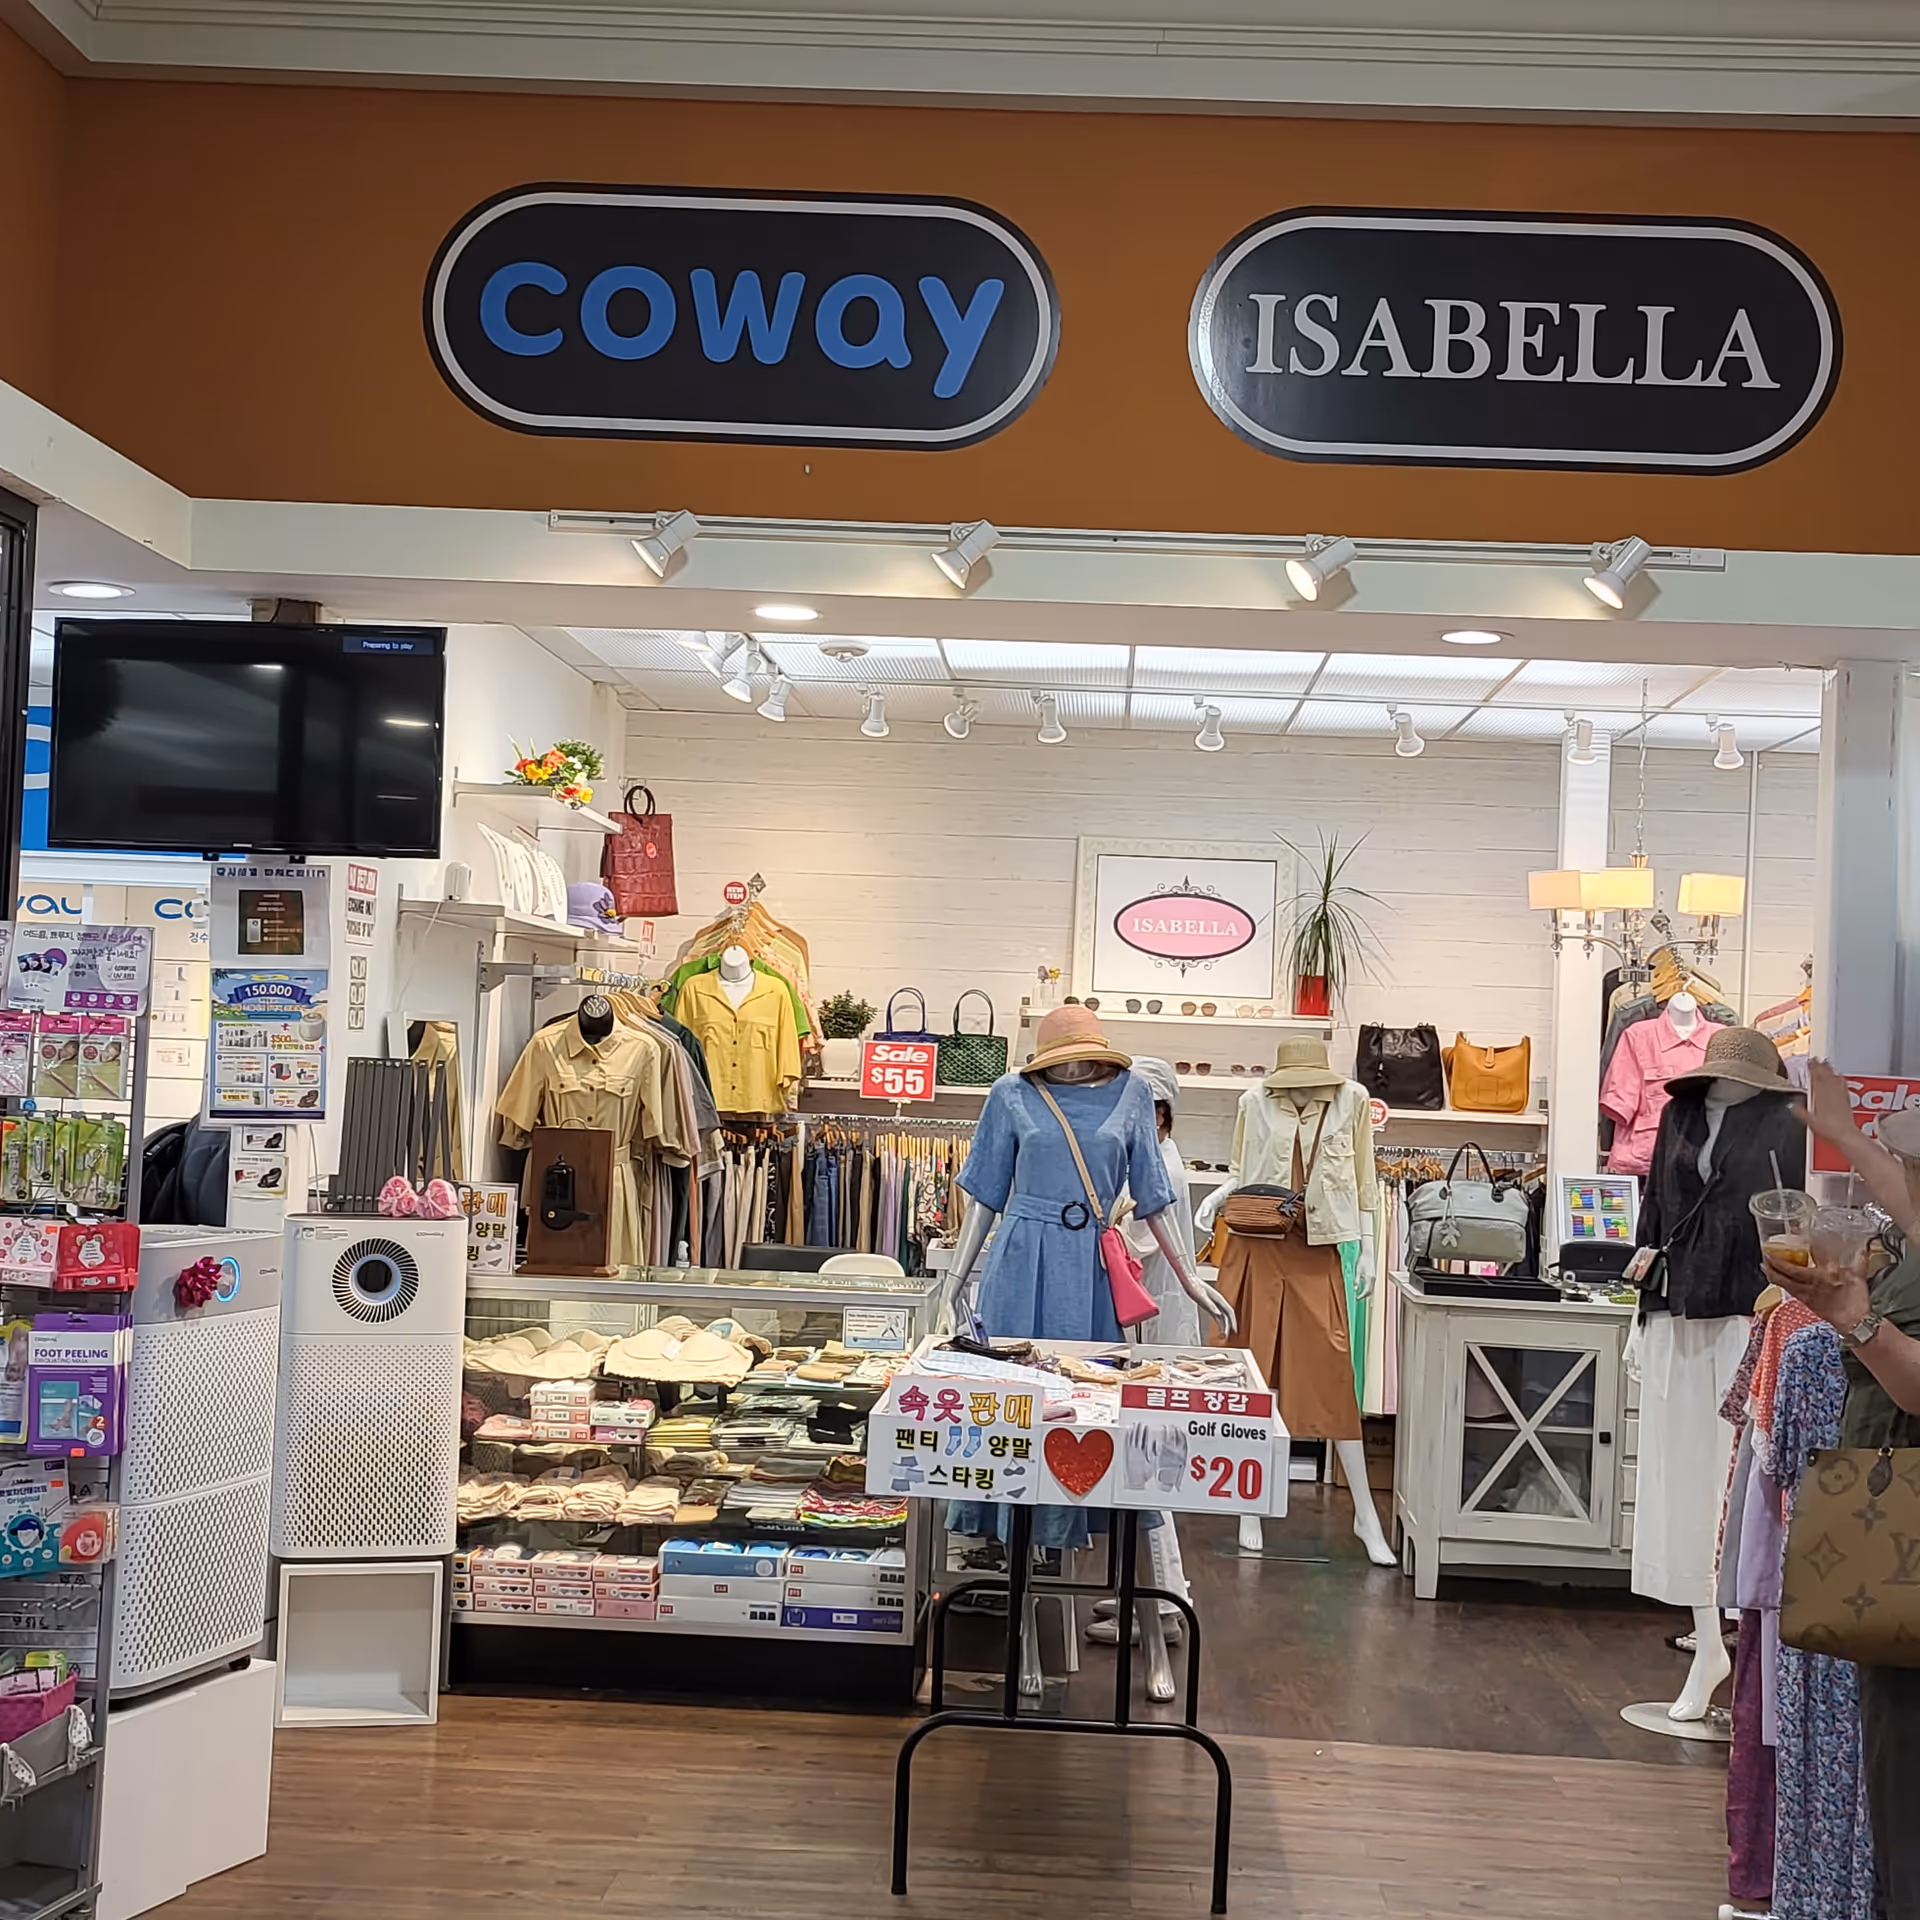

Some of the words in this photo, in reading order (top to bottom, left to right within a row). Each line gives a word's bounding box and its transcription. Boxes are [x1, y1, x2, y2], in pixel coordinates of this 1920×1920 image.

[480, 262, 1004, 398] coway
[1245, 293, 1781, 389] ISABELLA
[362, 641, 390, 650] Preparing
[392, 641, 399, 649] to
[400, 642, 414, 651] play
[1133, 918, 1239, 936] ISABELLA
[871, 1044, 929, 1063] Sale
[870, 1067, 925, 1095] $55
[475, 1222, 507, 1239] 양말
[34, 1348, 62, 1358] FOOT
[64, 1349, 109, 1359] PEELING
[1147, 1388, 1191, 1408] 골프
[1203, 1391, 1249, 1412] 장갑
[96, 1416, 105, 1427] 2
[1188, 1420, 1217, 1437] Golf
[1220, 1422, 1267, 1441] Gloves
[896, 1428, 938, 1452] 팬티
[988, 1435, 1032, 1459] 양말
[928, 1465, 994, 1490] 스타킹
[1190, 1454, 1262, 1500] $20
